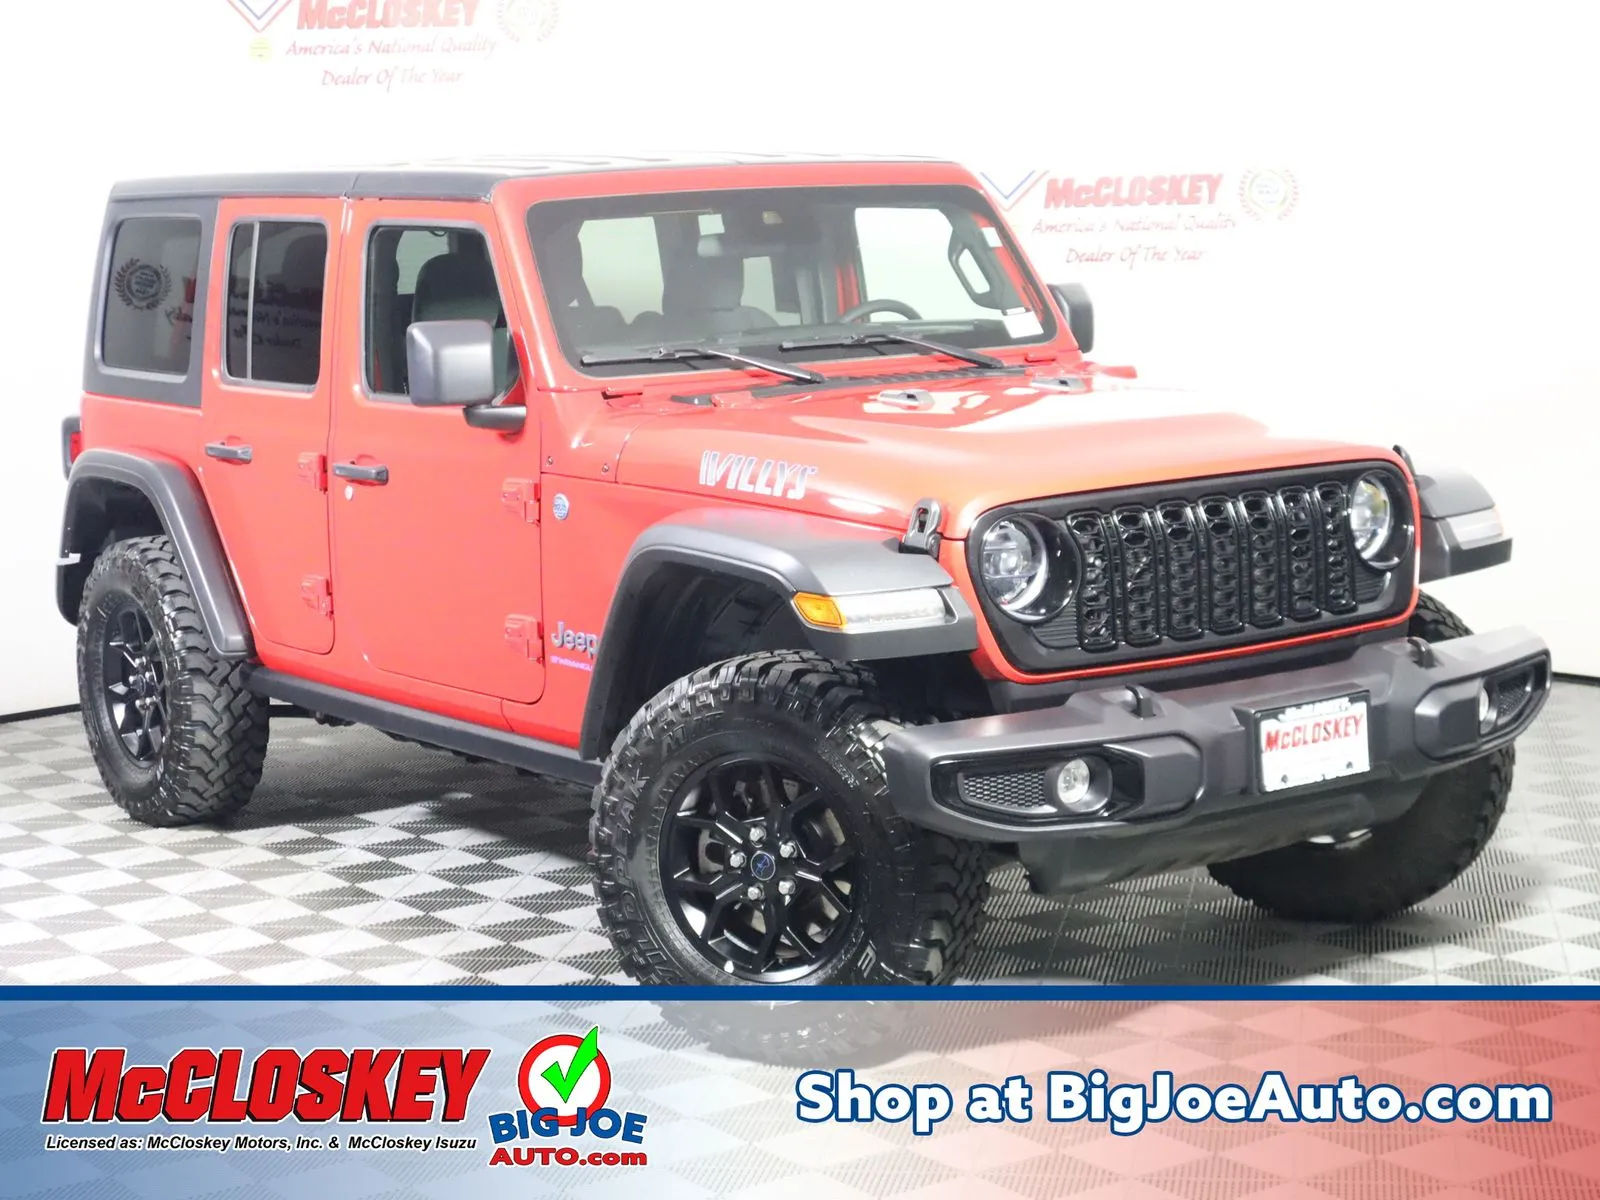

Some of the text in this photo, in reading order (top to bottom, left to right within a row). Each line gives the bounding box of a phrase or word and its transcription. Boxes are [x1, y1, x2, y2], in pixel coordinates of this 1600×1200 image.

[297, 0, 480, 30] McCLOSKEY
[285, 37, 363, 58] America's
[367, 31, 435, 55] National
[440, 32, 497, 60] Quality
[321, 66, 465, 93] Dealer Of The Year
[1044, 174, 1224, 210] McCLOSKEY
[1032, 212, 1237, 235] America's National Quality
[1066, 245, 1207, 271] Dealer Of The Year
[698, 449, 818, 500] WILLYS
[550, 621, 600, 660] Jeep
[1264, 713, 1363, 752] McCLOSKEY
